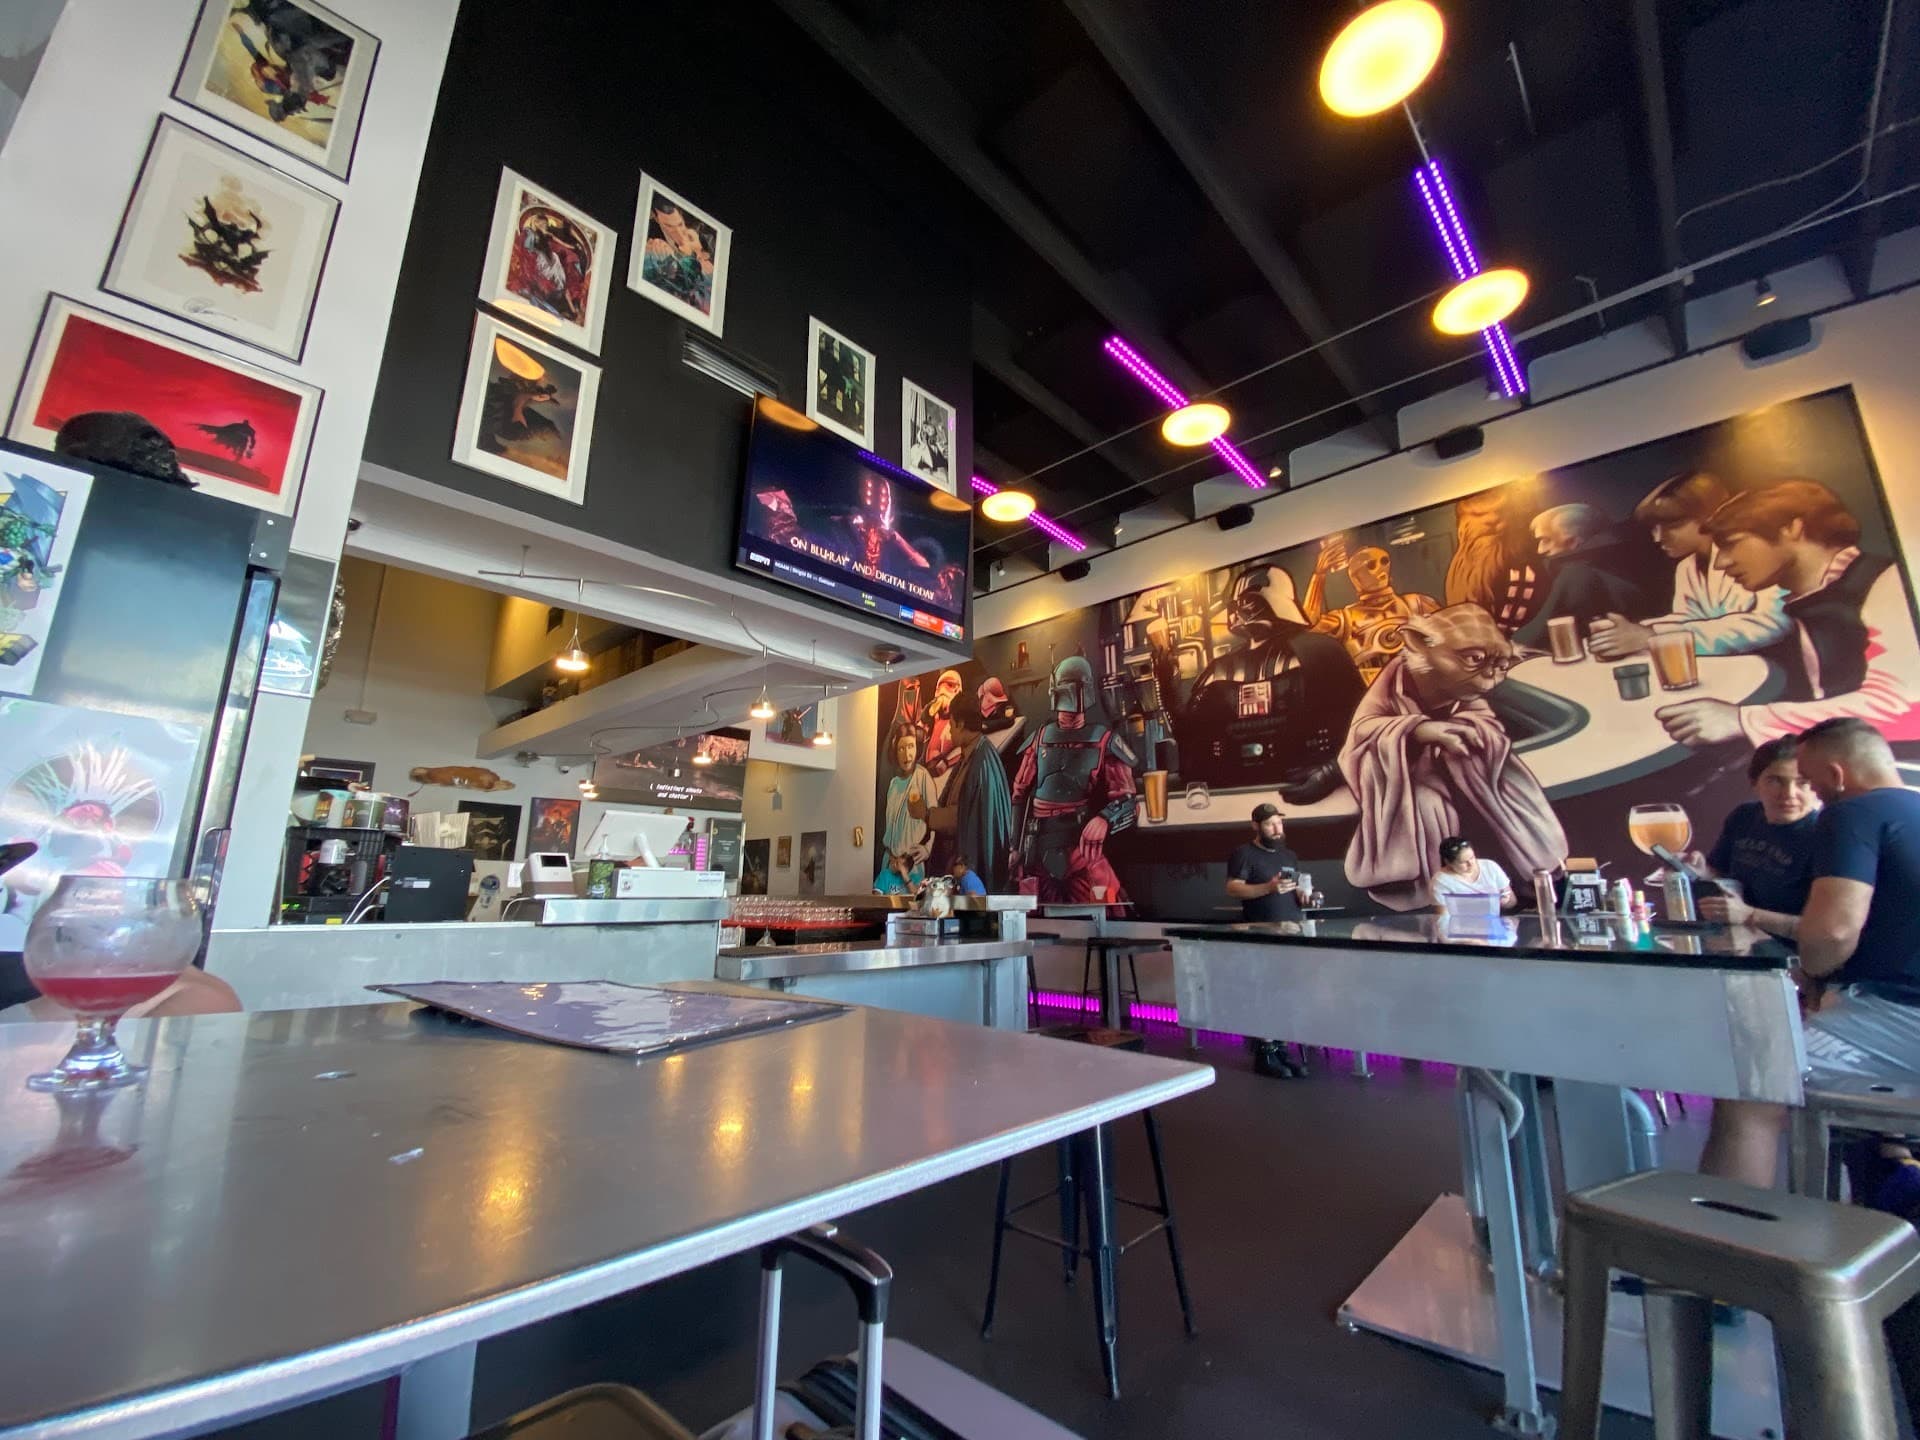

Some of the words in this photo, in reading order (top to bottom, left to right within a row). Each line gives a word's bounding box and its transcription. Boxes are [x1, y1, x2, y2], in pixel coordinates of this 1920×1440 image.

[791, 536, 808, 551] ON
[852, 561, 873, 577] AND
[875, 570, 907, 590] DIGITAL
[908, 582, 935, 601] TODAY
